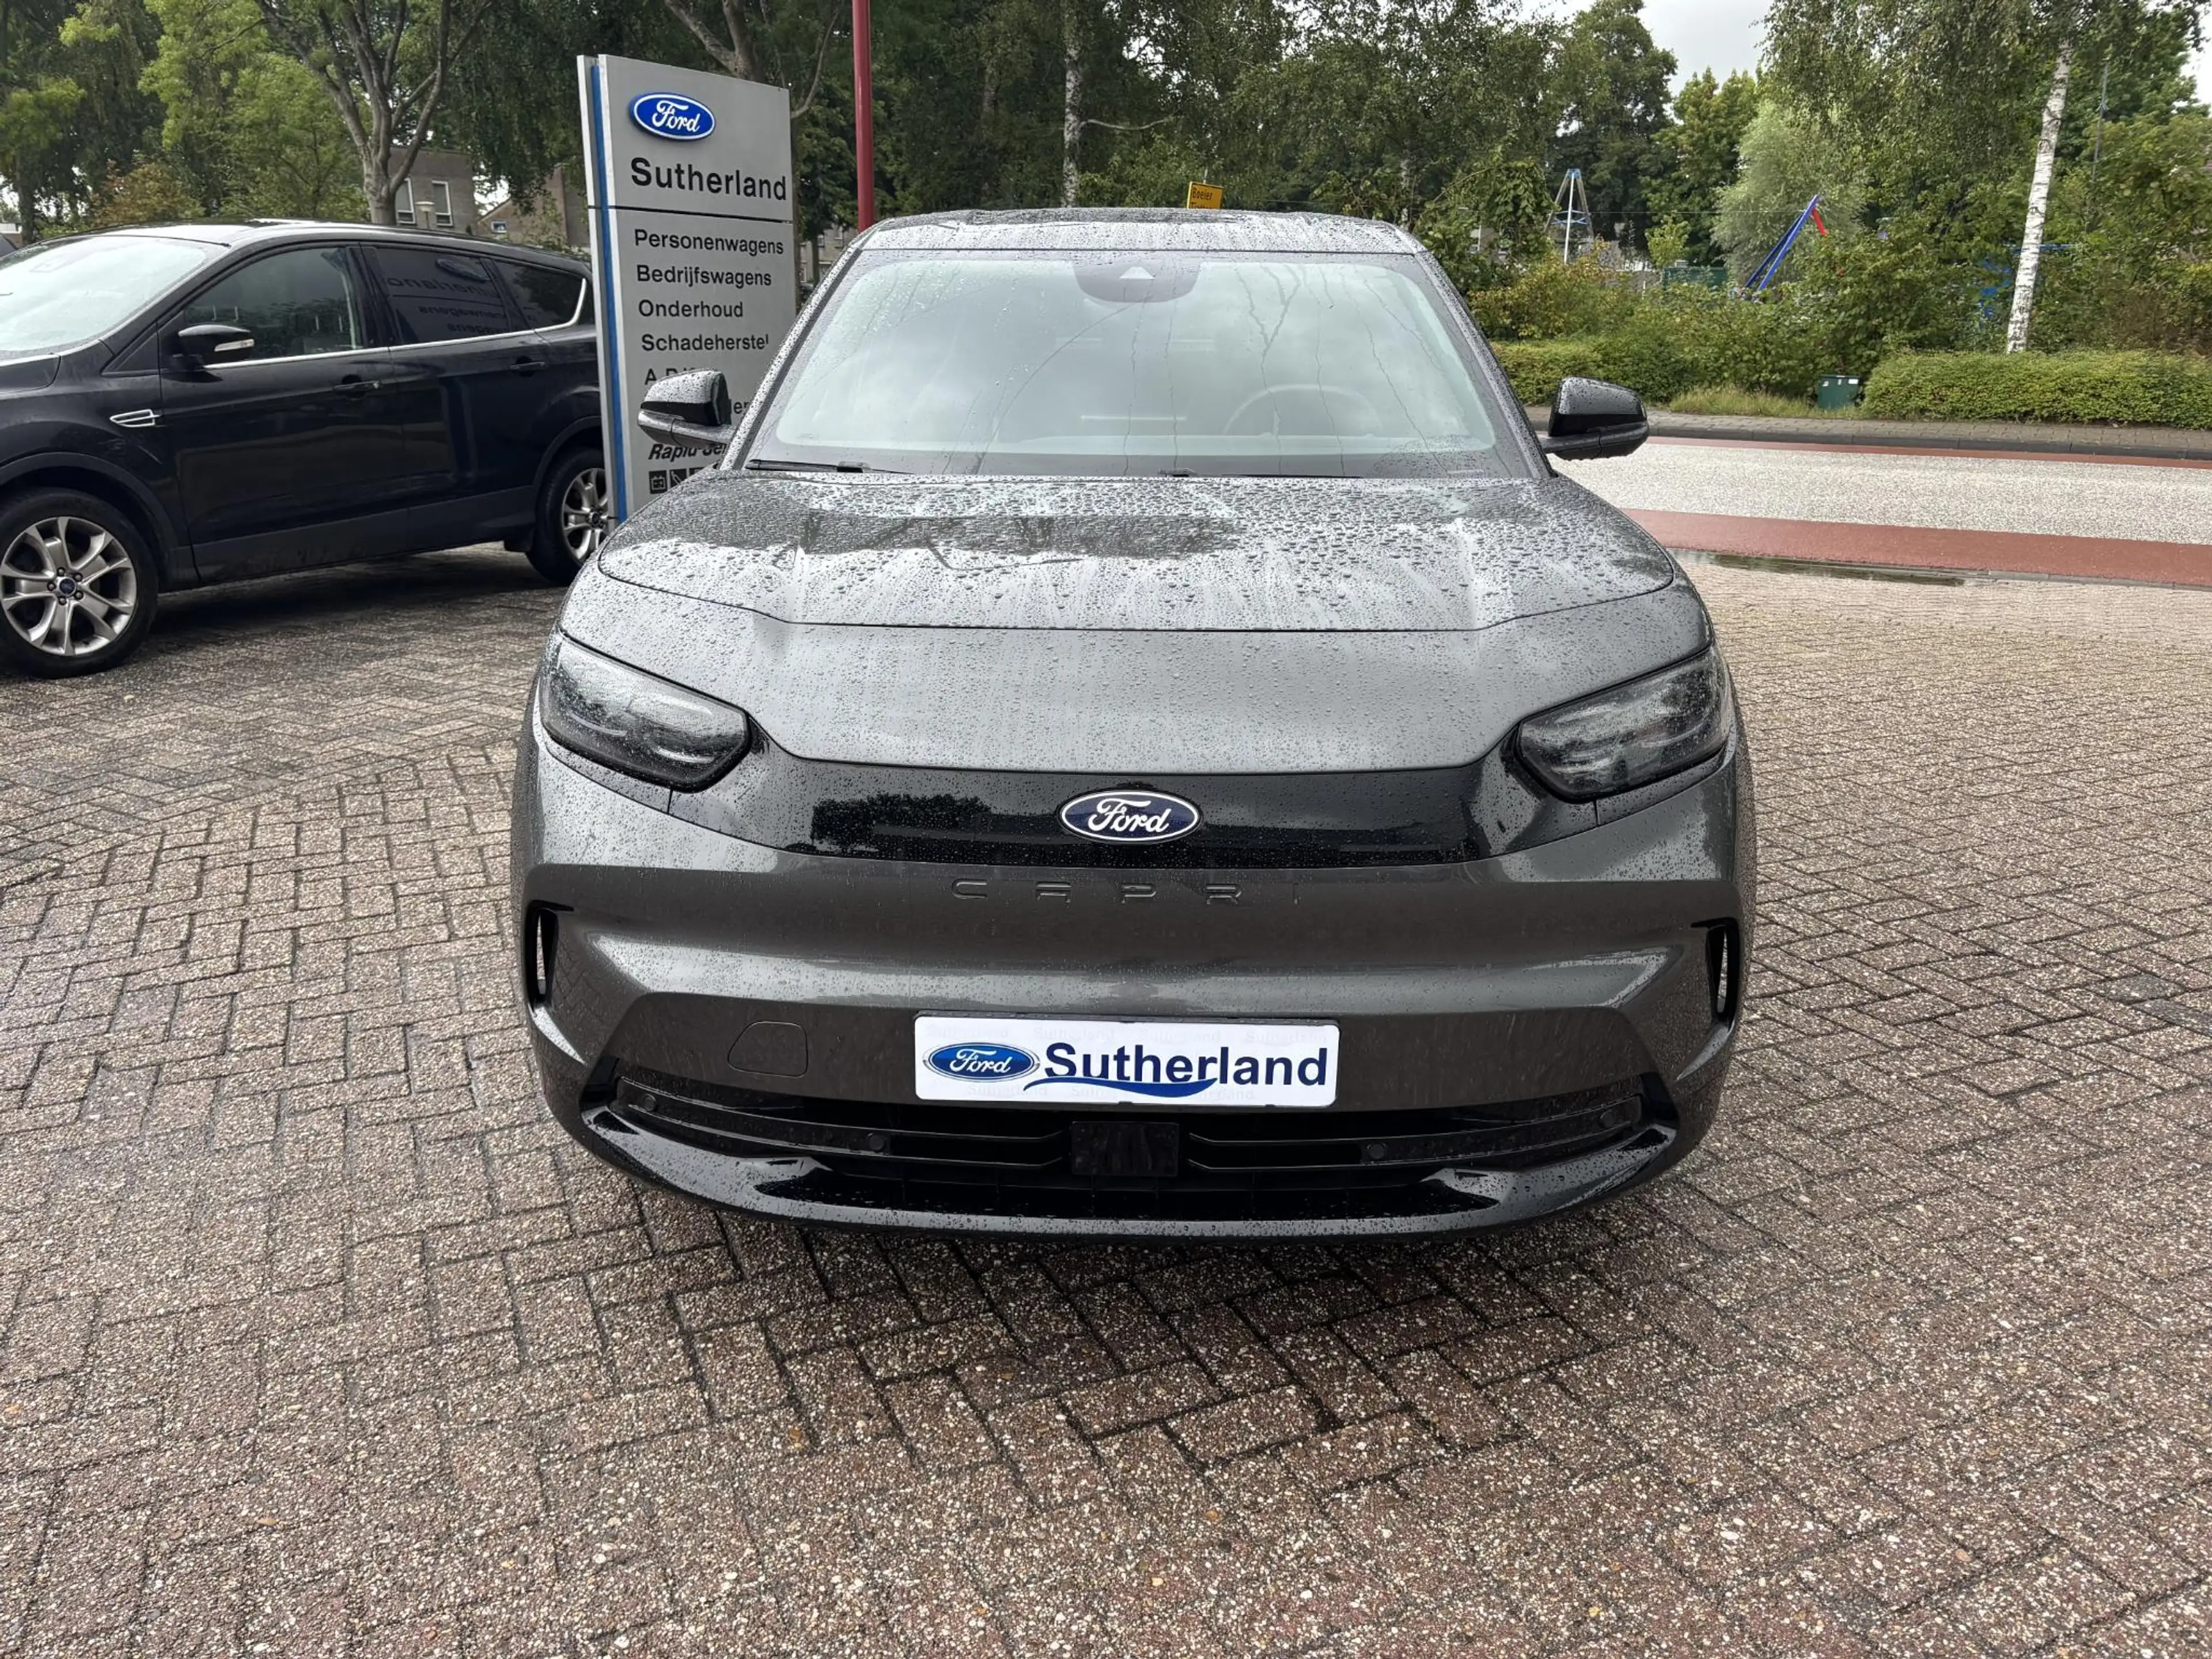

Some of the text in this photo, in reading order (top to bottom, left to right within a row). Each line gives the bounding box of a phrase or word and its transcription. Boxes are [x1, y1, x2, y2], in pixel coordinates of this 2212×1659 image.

[652, 100, 700, 132] Ford
[631, 157, 787, 200] Sutherland
[635, 229, 784, 257] Personenwagens
[637, 264, 772, 289] Bedrijfswagens
[639, 299, 744, 317] Onderhoud
[1088, 797, 1170, 835] Ford
[950, 1041, 1327, 1086] Ford Sutherland
